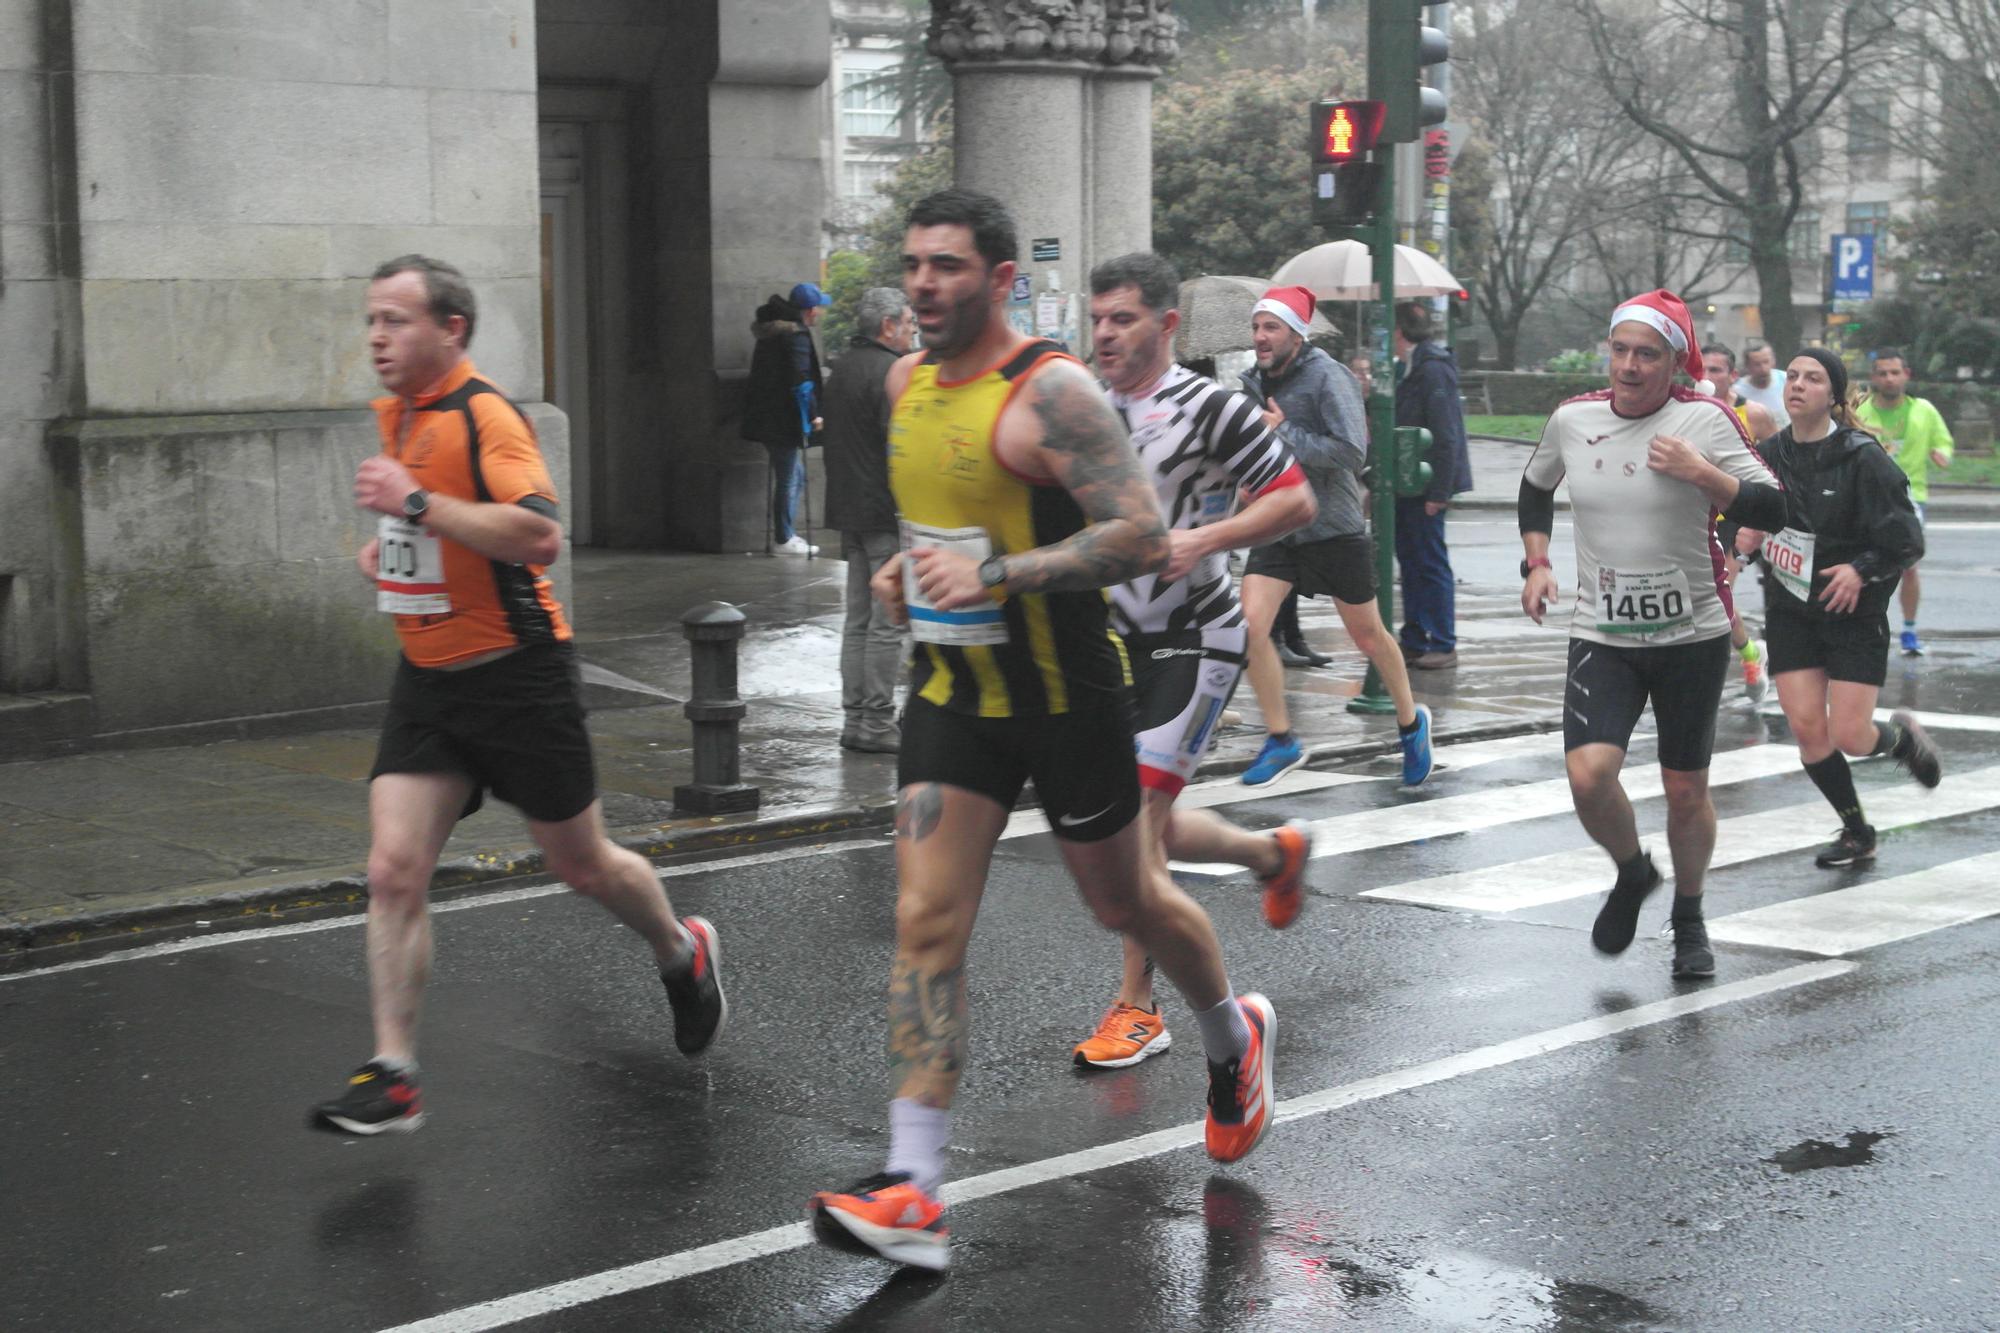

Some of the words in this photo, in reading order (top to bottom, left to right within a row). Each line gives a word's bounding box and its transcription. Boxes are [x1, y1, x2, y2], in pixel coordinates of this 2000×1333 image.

[1839, 238, 1862, 278] P
[1766, 540, 1803, 576] 1109
[1602, 590, 1684, 621] 1460
